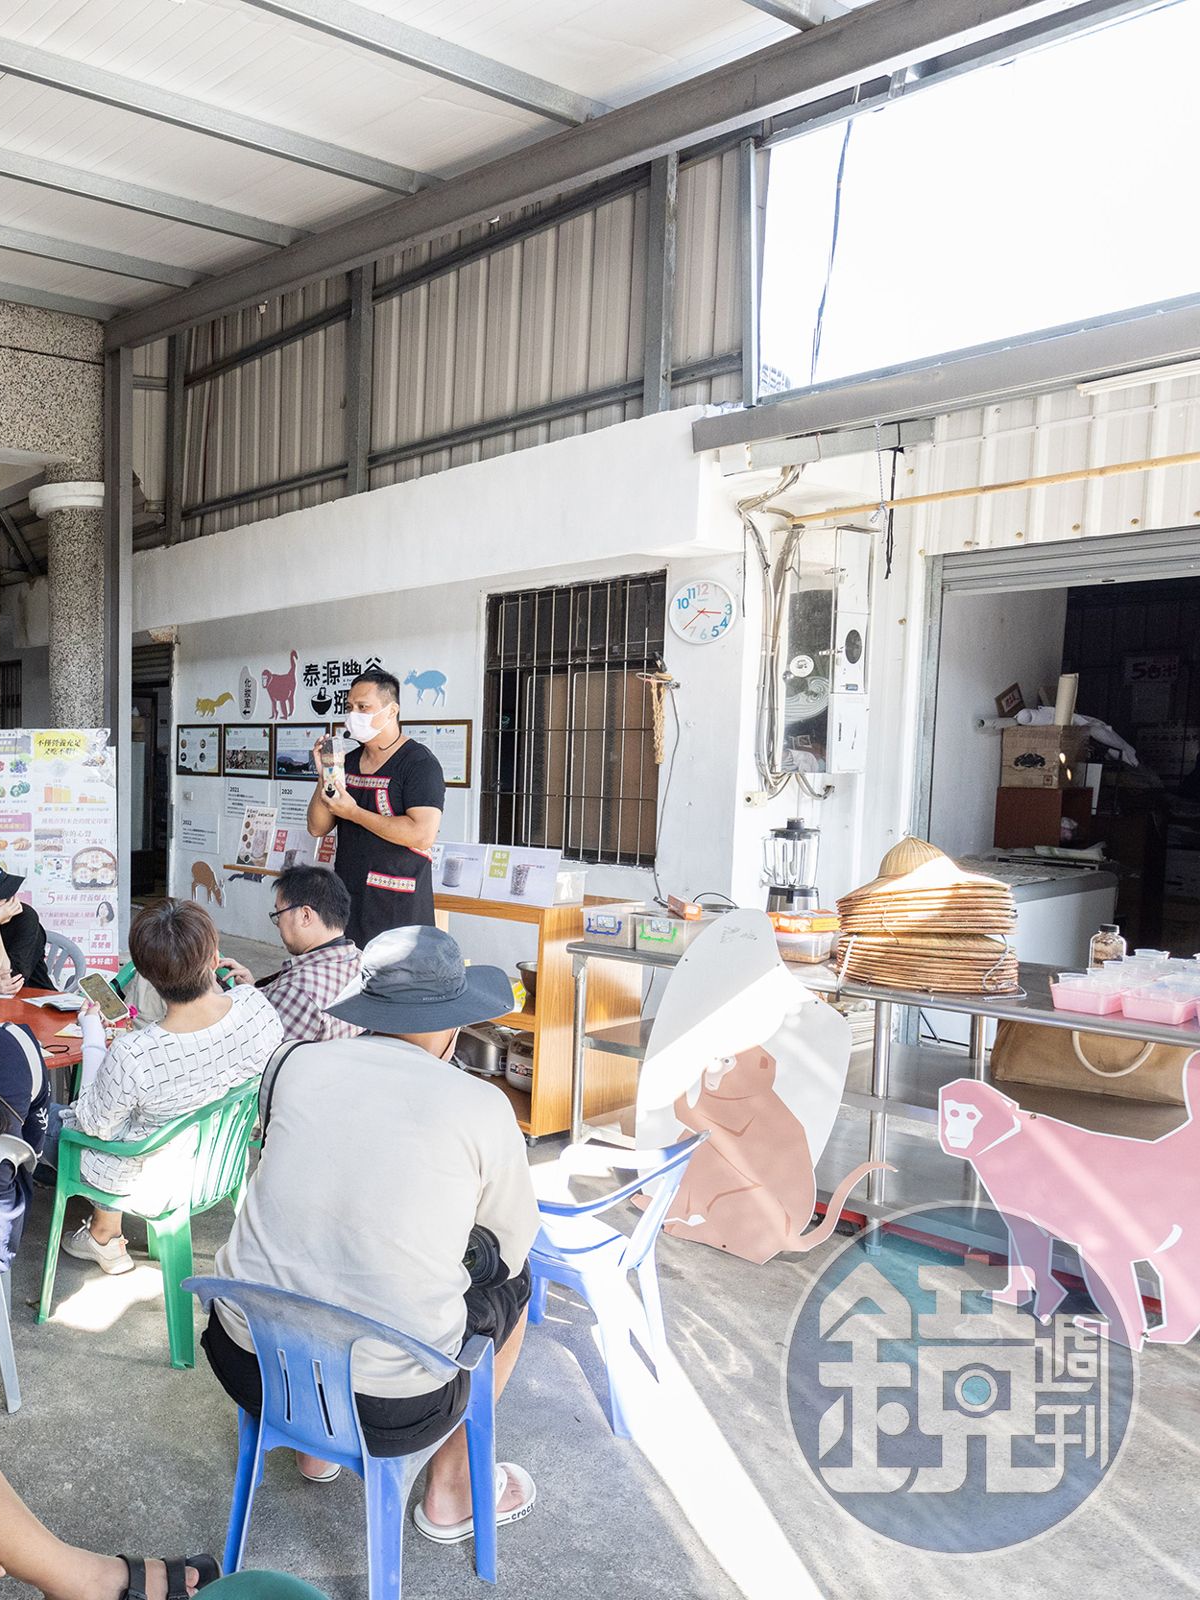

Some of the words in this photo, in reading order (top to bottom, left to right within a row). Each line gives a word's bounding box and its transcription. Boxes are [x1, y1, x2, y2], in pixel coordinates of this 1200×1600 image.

[688, 588, 696, 599] 11
[697, 584, 709, 596] 12
[677, 598, 689, 609] 10
[725, 604, 732, 615] 3
[720, 617, 728, 628] 4
[700, 629, 707, 640] 6
[711, 626, 719, 637] 5
